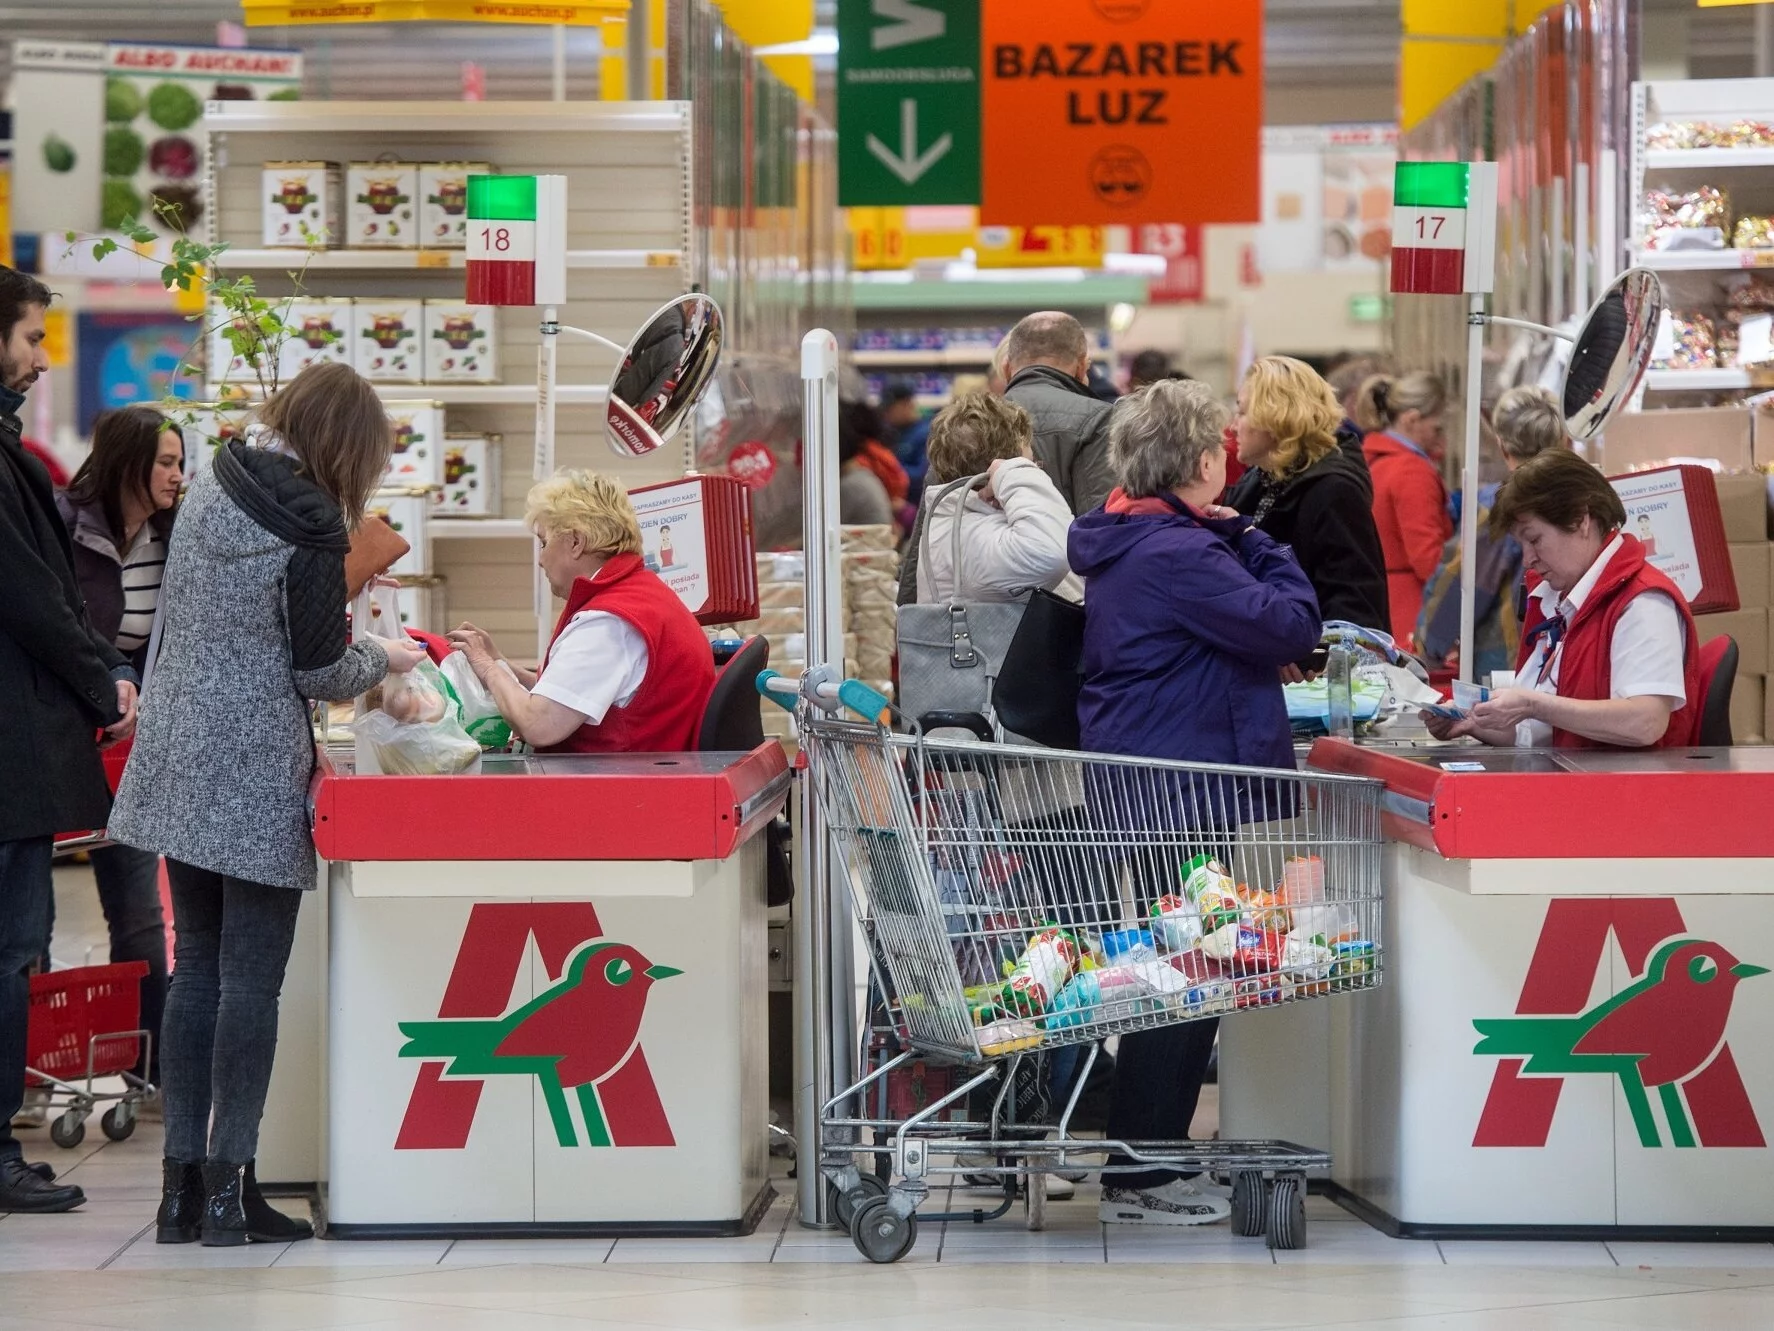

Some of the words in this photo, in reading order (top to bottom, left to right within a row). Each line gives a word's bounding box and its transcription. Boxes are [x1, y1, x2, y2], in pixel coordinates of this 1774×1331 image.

[995, 41, 1243, 78] BAZAREK
[1068, 90, 1168, 125] LUZ
[1416, 215, 1446, 240] 17
[482, 228, 510, 252] 18
[681, 493, 697, 501] KASY
[1637, 501, 1669, 515] DOBRY
[660, 513, 688, 526] DOBRY
[670, 573, 700, 585] posiada
